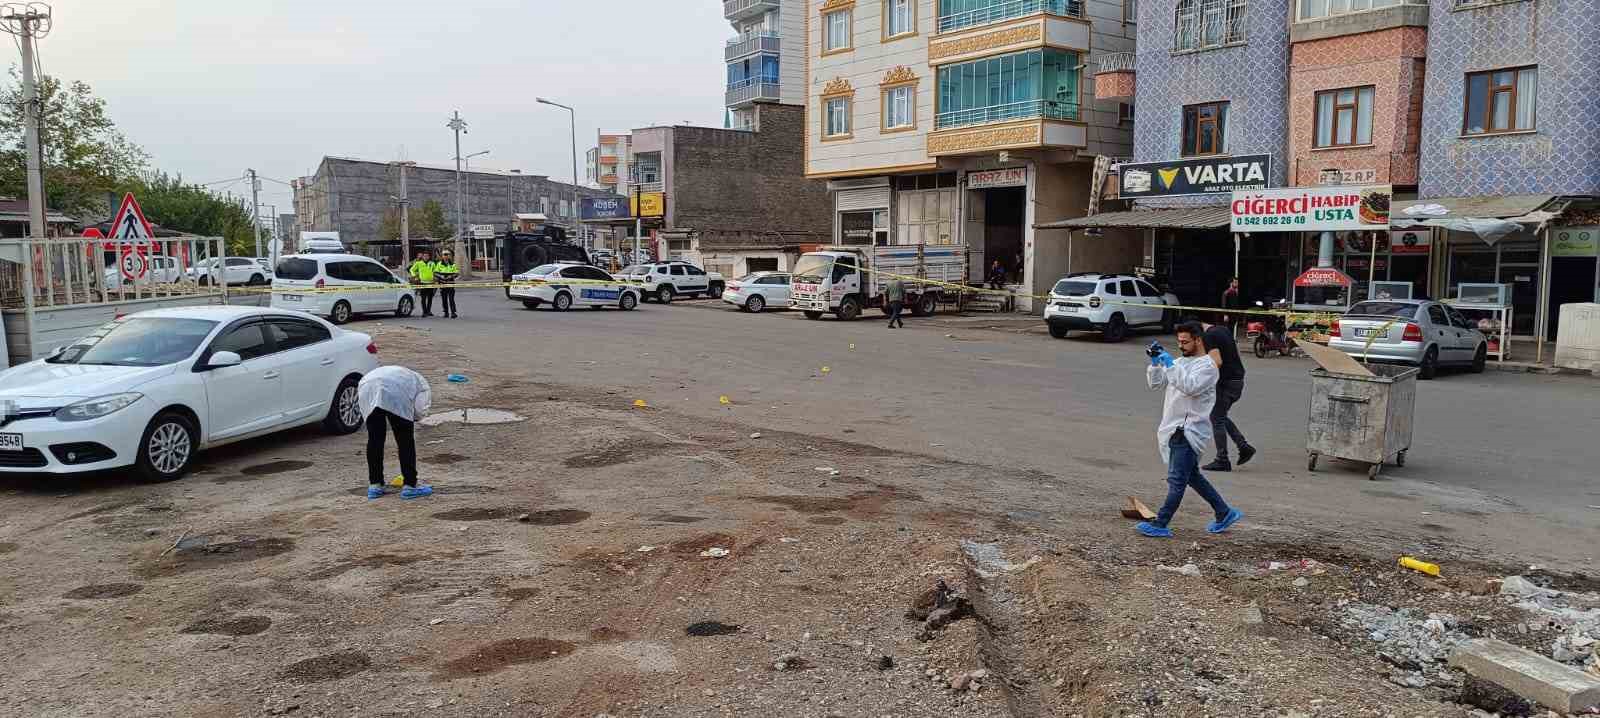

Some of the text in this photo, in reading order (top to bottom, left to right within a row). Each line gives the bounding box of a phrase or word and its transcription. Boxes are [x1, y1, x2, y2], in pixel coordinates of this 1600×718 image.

[1184, 162, 1264, 184] VARTA
[1232, 194, 1308, 215] CİĞERCİ
[1245, 217, 1260, 225] 542
[1315, 208, 1354, 221] USTA
